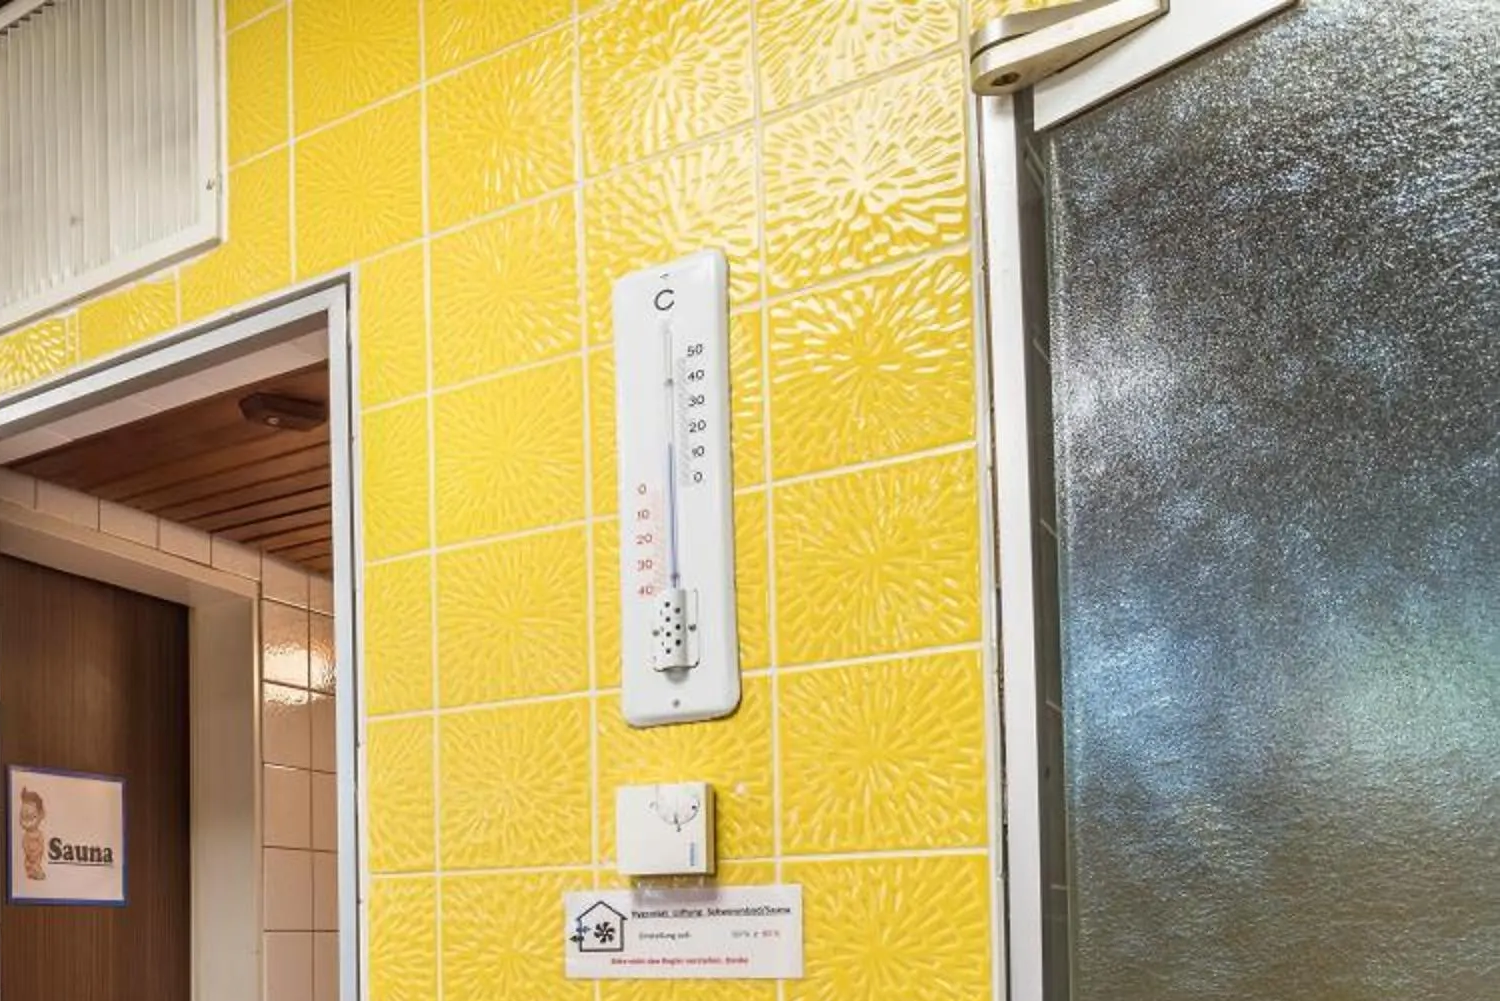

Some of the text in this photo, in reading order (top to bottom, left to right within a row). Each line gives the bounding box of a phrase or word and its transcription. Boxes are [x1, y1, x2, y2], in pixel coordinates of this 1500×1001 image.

[687, 344, 703, 357] 50
[687, 369, 705, 382] 40
[688, 395, 705, 407] 30
[689, 419, 707, 433] 20
[692, 446, 705, 457] 10
[693, 471, 703, 483] 0
[637, 483, 647, 495] 0
[637, 509, 650, 520] 10
[636, 533, 652, 545] 20
[637, 559, 653, 572] 30
[637, 585, 653, 596] 40
[48, 837, 113, 864] Sauna
